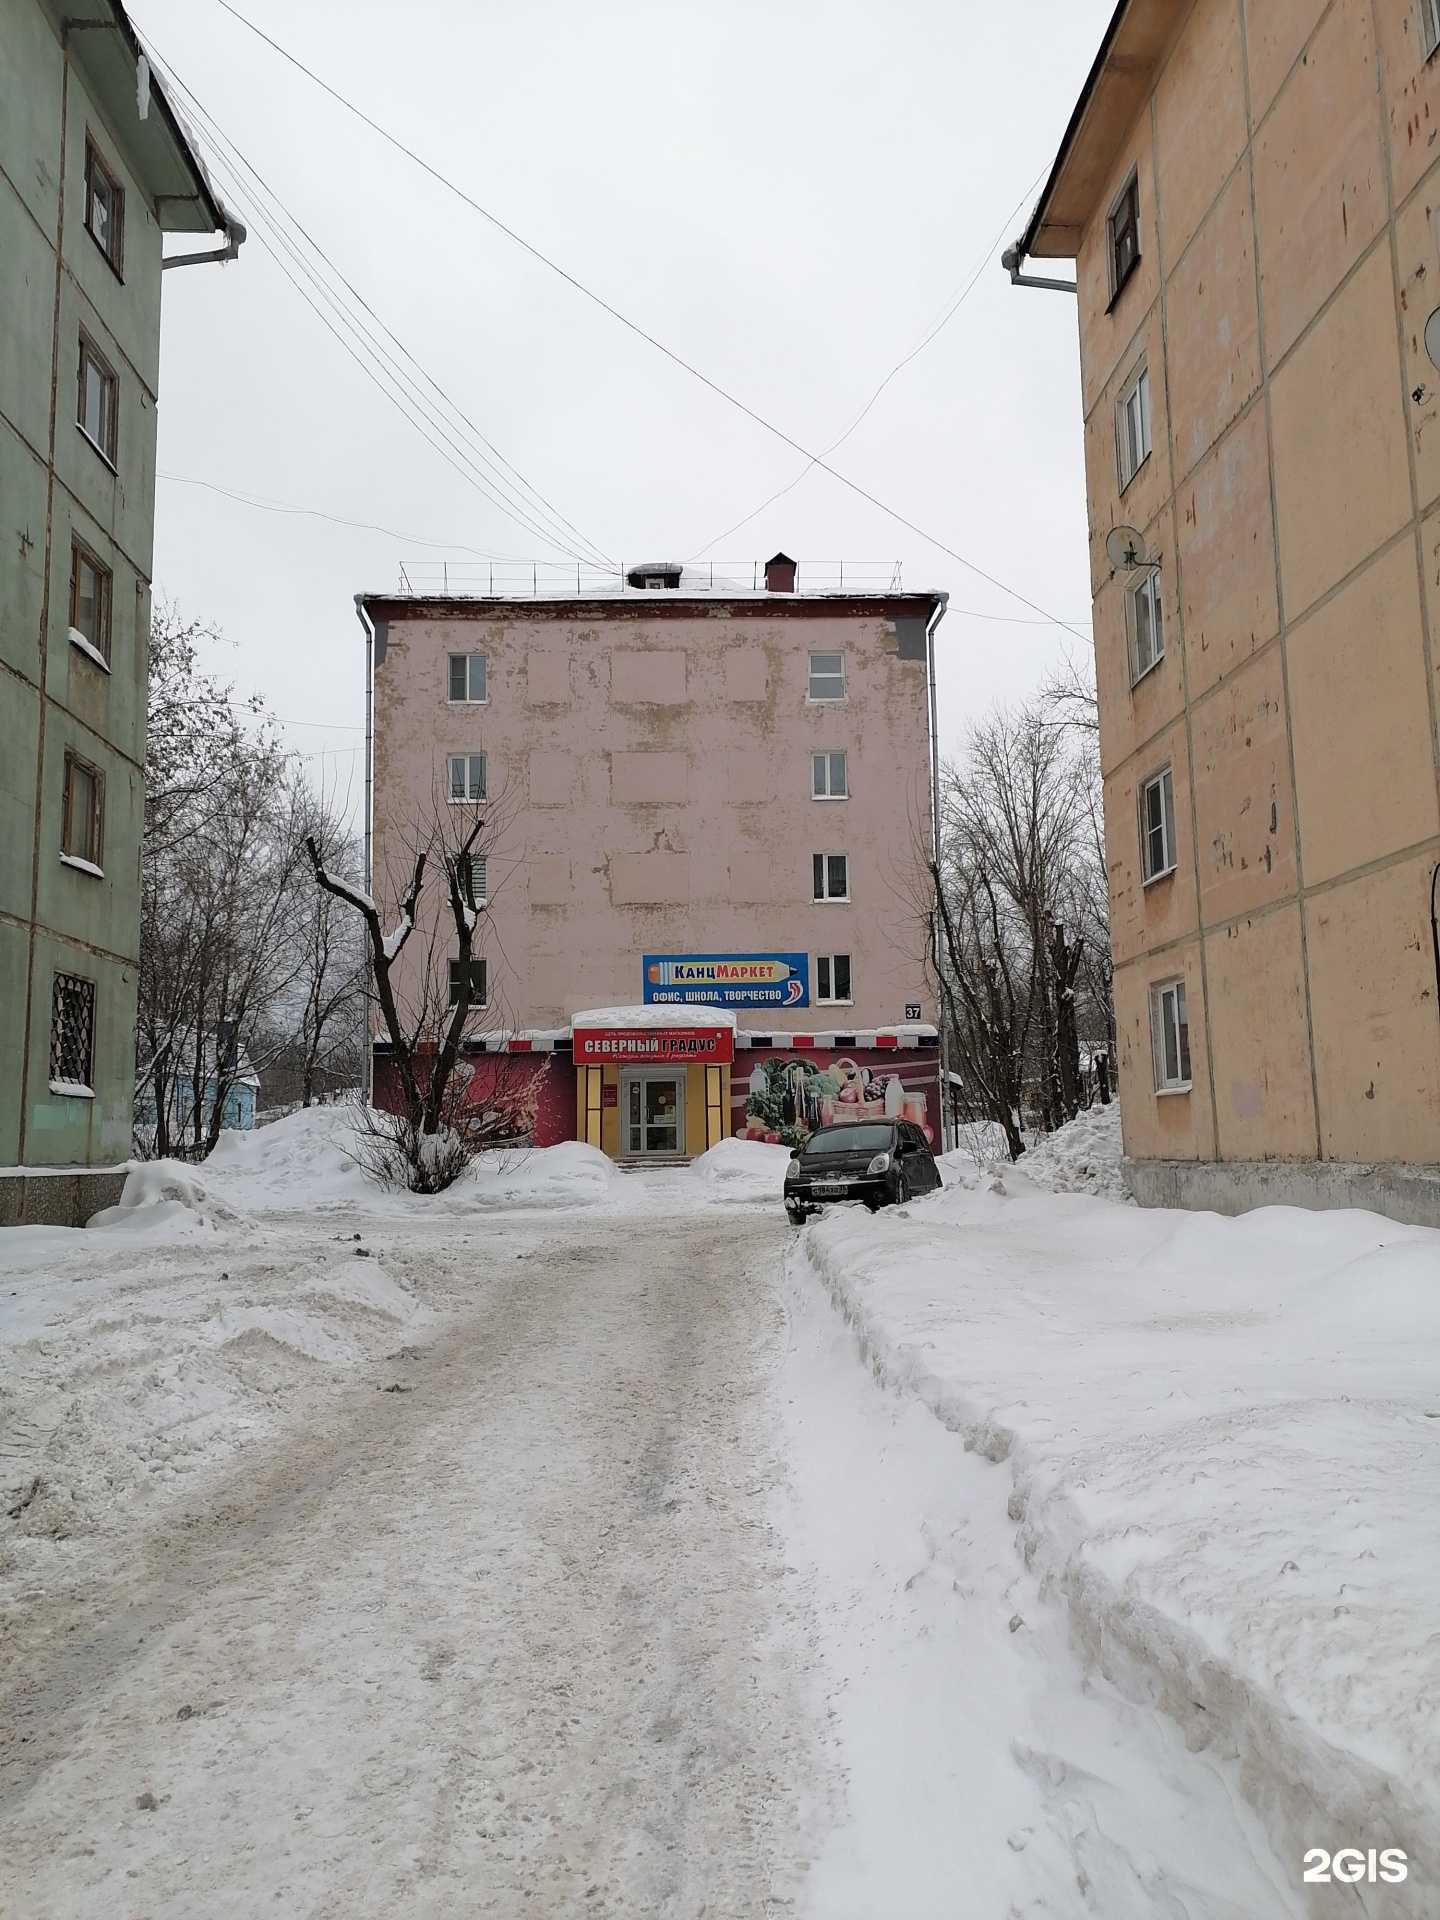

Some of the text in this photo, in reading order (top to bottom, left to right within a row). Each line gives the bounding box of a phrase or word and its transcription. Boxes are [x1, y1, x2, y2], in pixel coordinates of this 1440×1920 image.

[652, 990, 782, 1002] ОФИС, ШКОЛА, ТВОРЧЕСТВО
[906, 1007, 920, 1018] 37
[584, 1037, 716, 1054] СЕВЕРНЫЙ ГРАДУС
